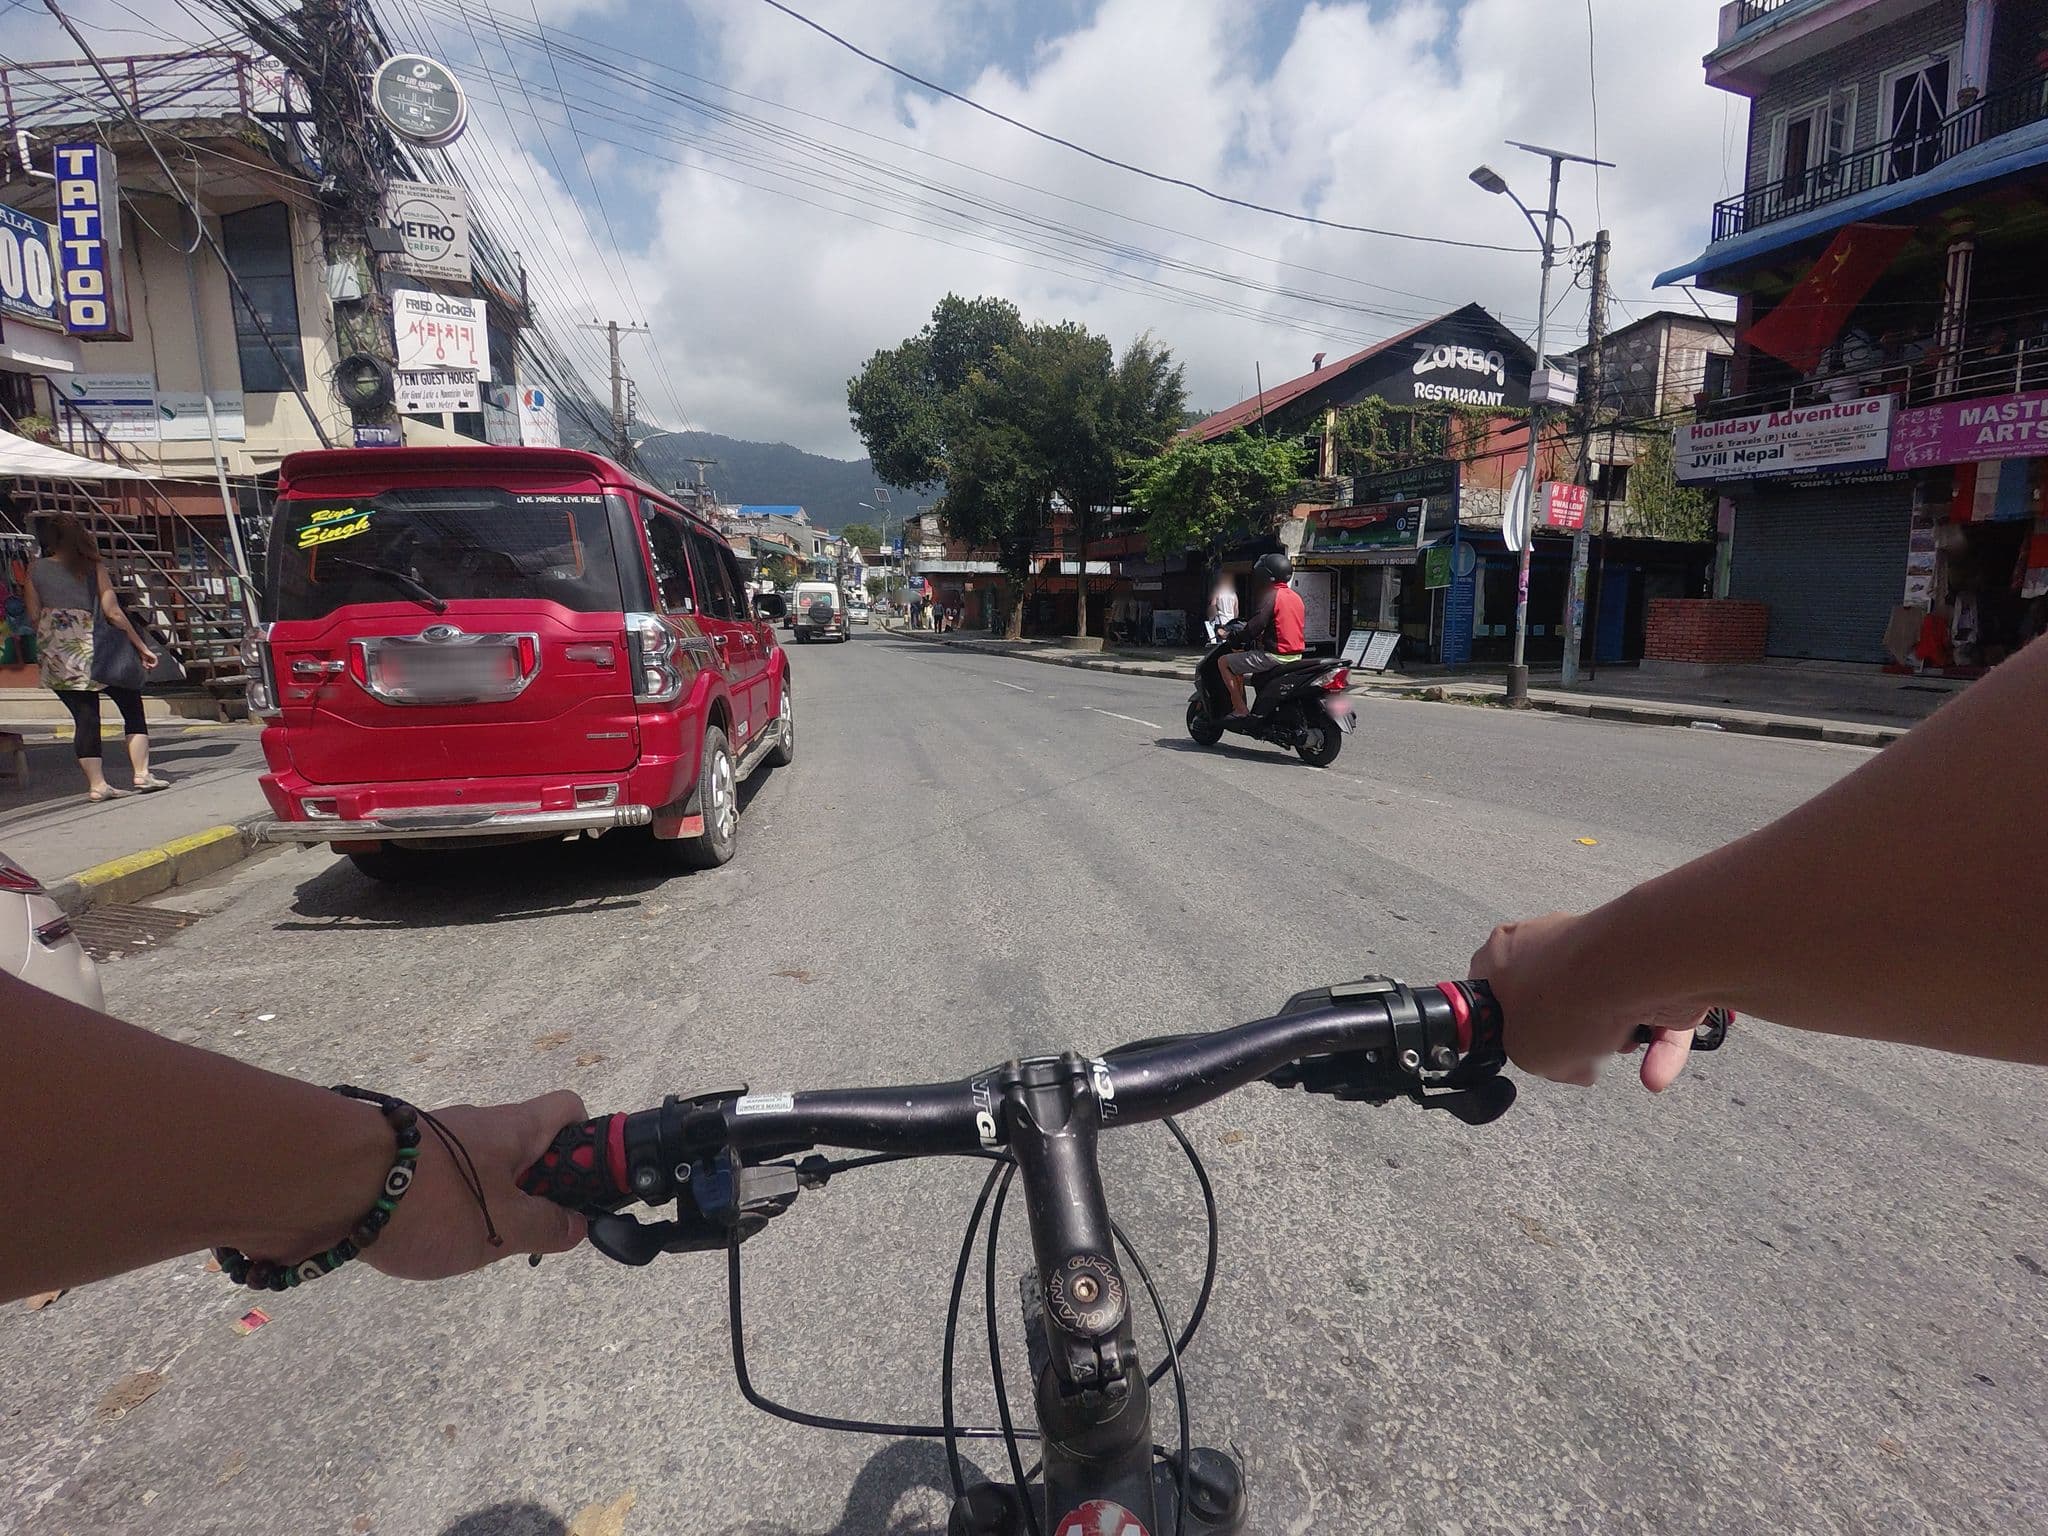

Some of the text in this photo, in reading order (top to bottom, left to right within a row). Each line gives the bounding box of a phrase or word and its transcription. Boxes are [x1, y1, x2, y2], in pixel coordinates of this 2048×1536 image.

[58, 149, 107, 326] TATTOO
[406, 298, 476, 318] FRIED CHICKEN
[409, 319, 479, 365] 사랑치킨
[1412, 342, 1505, 386] ZORBA
[420, 371, 446, 385] GUEST
[448, 370, 475, 385] HOUSE
[1413, 382, 1505, 406] RESTAURANT
[1690, 419, 1761, 440] Holiday
[1767, 400, 1881, 428] Adventure
[1976, 419, 2048, 444] ARTS
[1690, 444, 1714, 452] Tours
[1716, 441, 1724, 449] &
[1727, 436, 1762, 447] Travels
[1733, 444, 1785, 464] Nepal
[563, 496, 580, 504] LIVE
[581, 496, 602, 504] FREE
[311, 507, 356, 524] Riya
[298, 514, 372, 548] Singh
